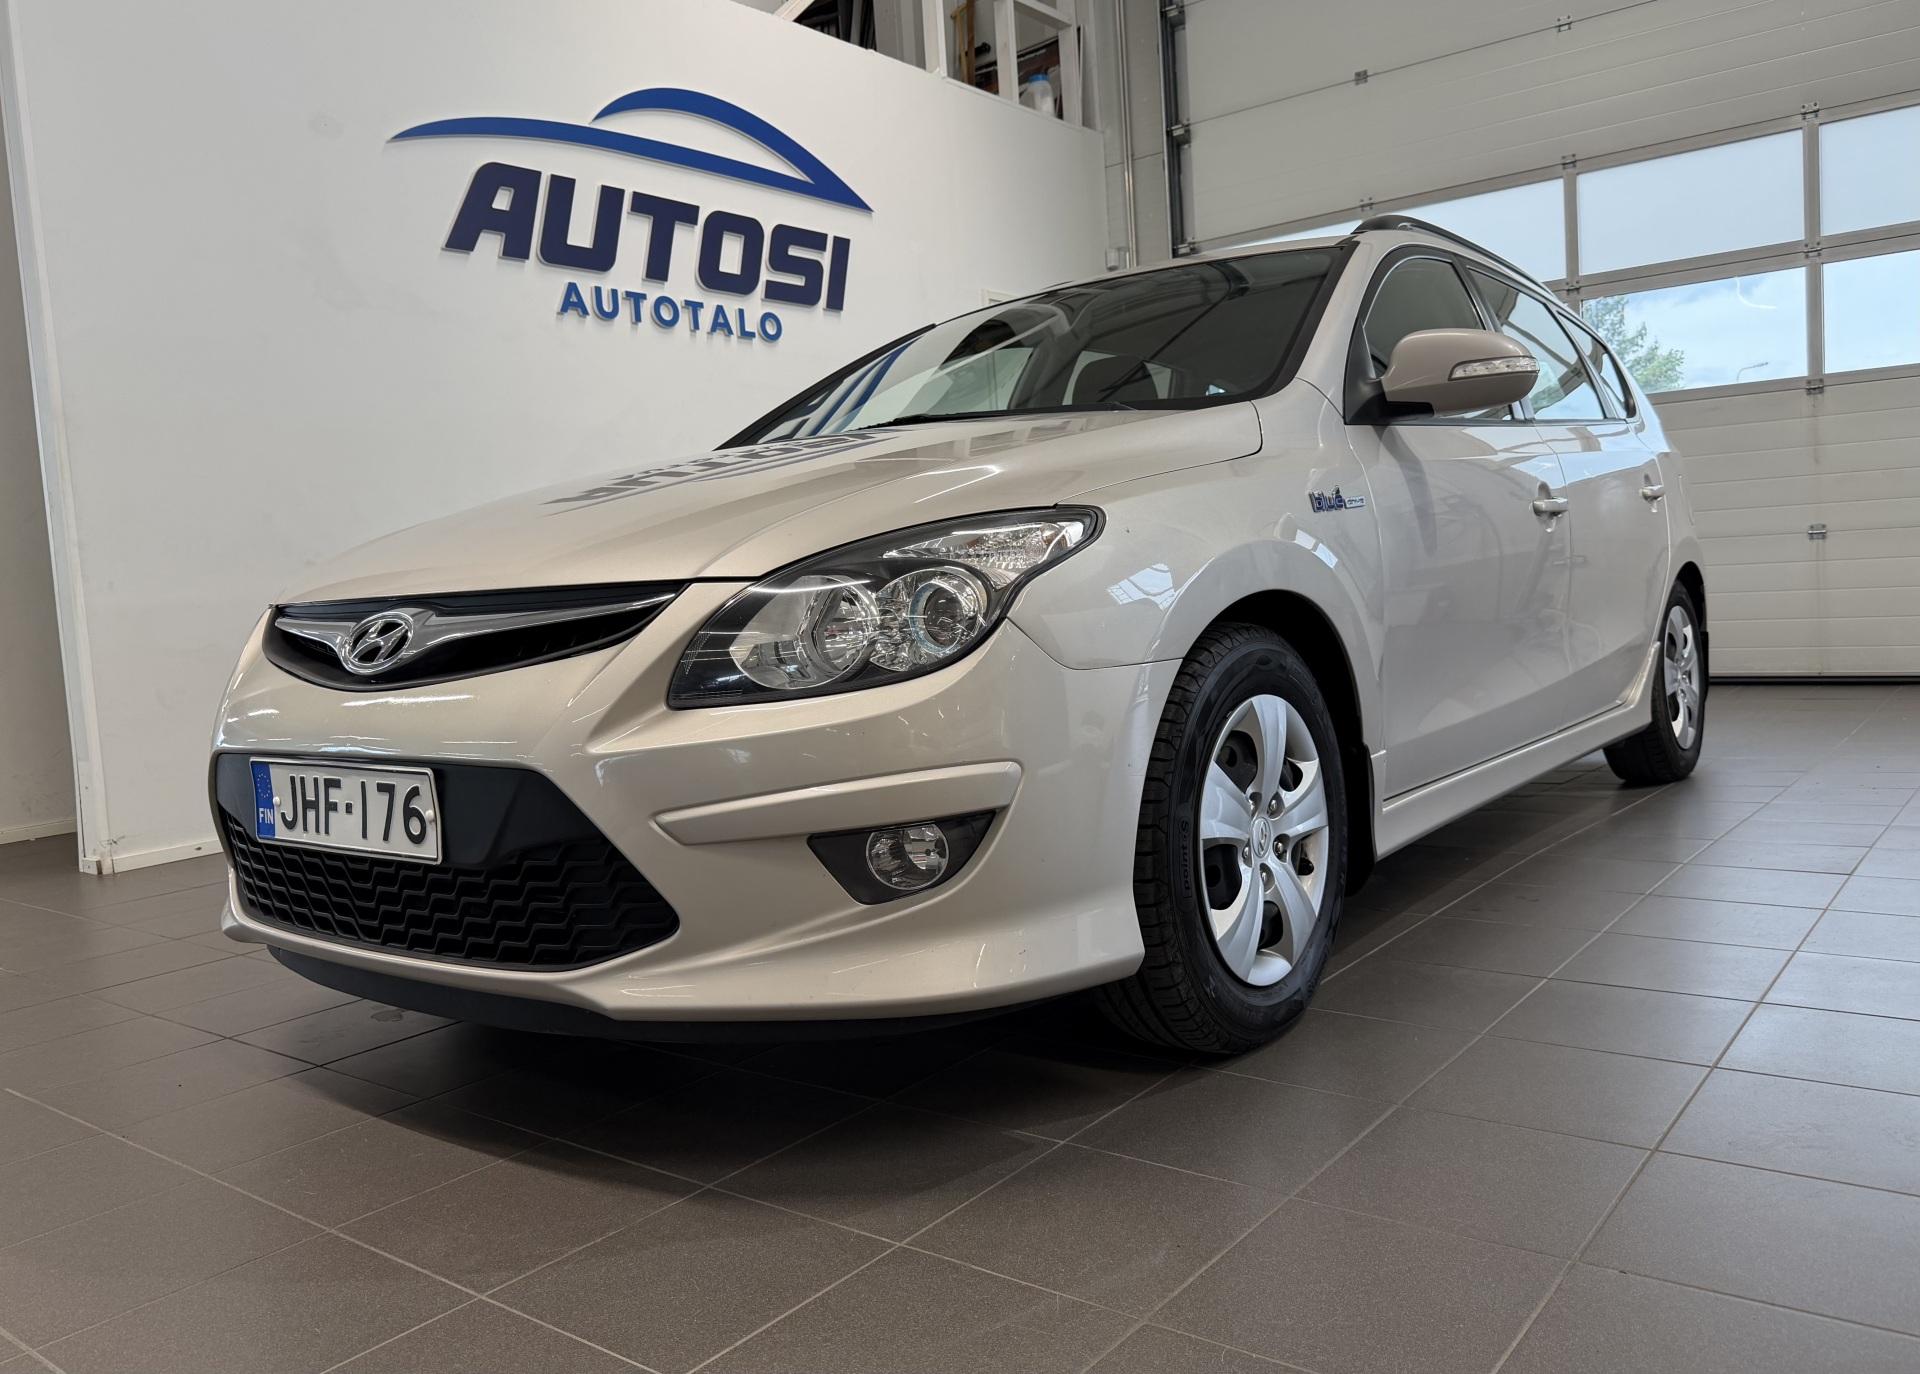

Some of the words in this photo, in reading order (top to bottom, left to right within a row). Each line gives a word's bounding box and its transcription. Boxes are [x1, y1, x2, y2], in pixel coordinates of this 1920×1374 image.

[443, 161, 851, 311] AUTOSI
[558, 281, 783, 343] AUTOTALO
[259, 808, 274, 825] FIN
[280, 774, 427, 844] JHF-176
